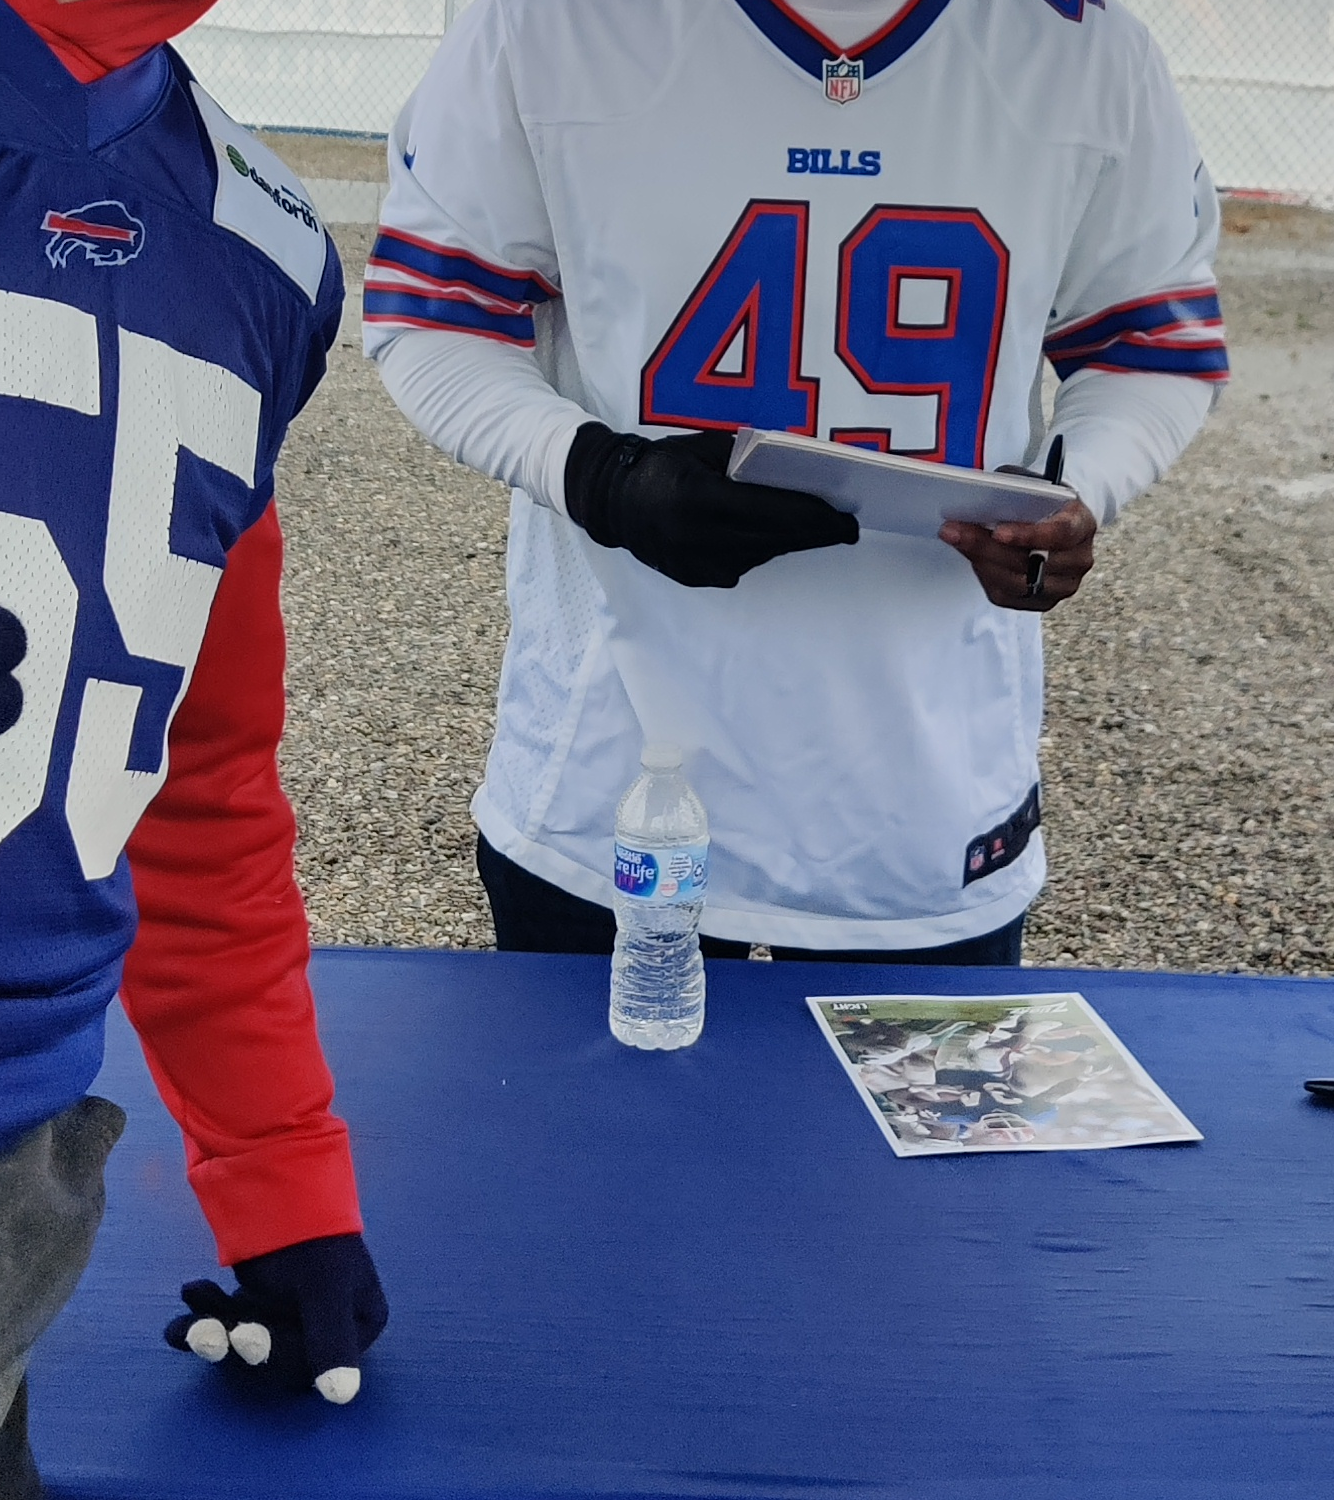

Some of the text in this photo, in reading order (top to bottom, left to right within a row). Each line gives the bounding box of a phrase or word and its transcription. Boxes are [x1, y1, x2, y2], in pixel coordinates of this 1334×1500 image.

[829, 78, 857, 99] NFL
[786, 147, 882, 177] BILLS
[639, 198, 1011, 470] 49
[630, 862, 656, 884] Life
